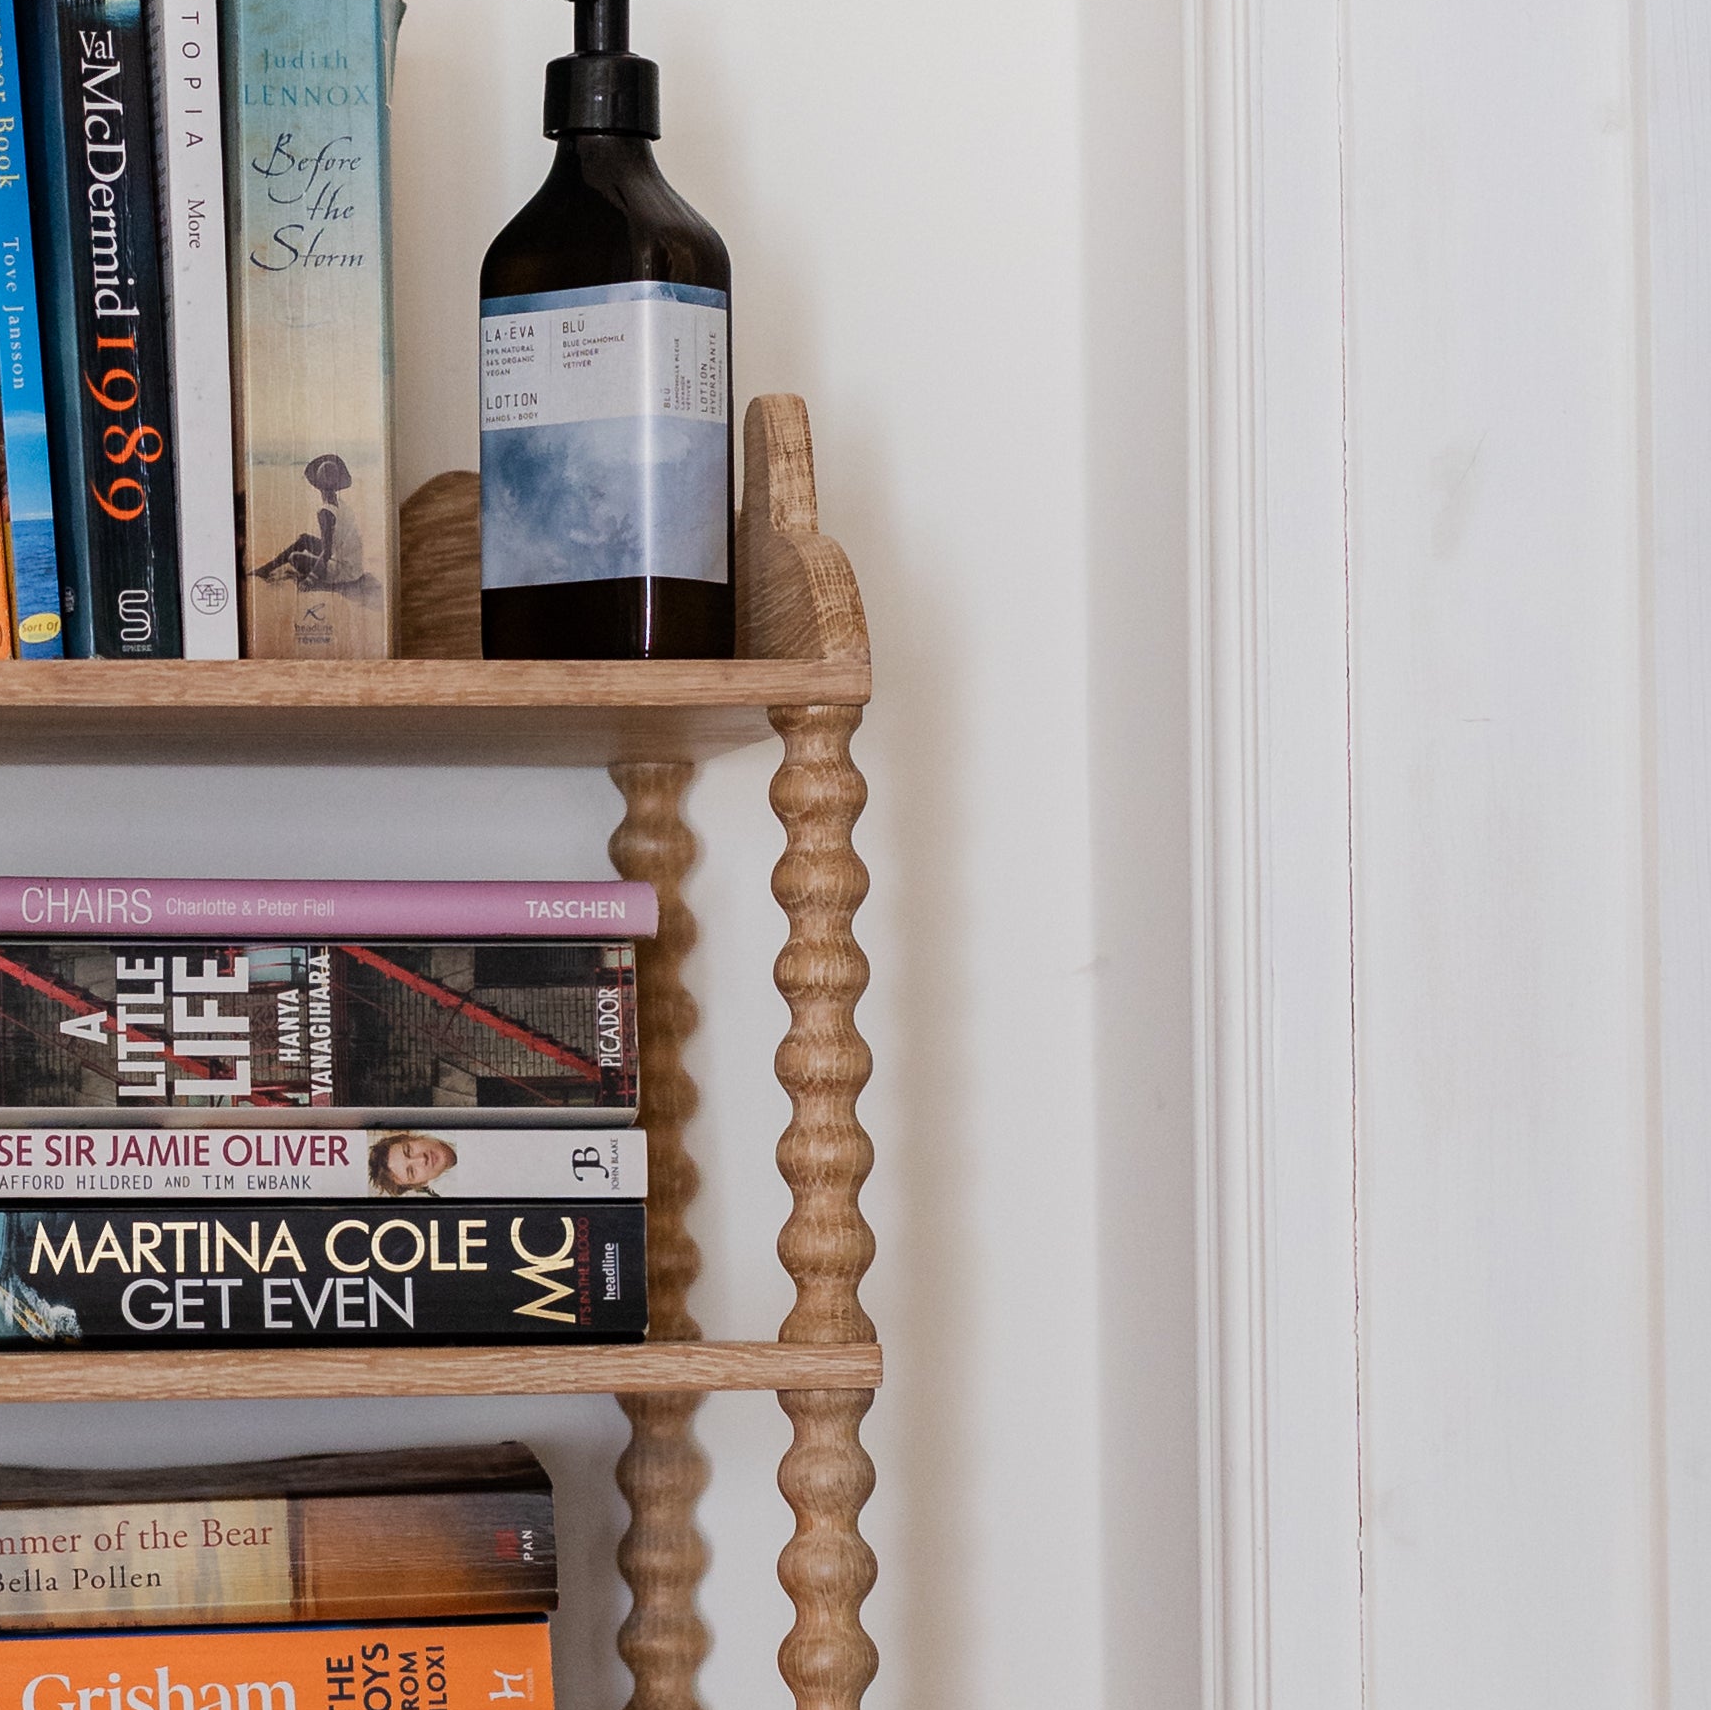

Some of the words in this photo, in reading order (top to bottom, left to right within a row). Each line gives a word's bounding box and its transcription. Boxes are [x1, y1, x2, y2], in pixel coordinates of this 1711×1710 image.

[79, 31, 114, 59] Val
[263, 49, 348, 73] Judith
[244, 85, 369, 106] LENNOX
[81, 60, 140, 319] McDermid
[252, 133, 361, 204] Before
[188, 198, 205, 250] More
[3, 238, 20, 293] Tove
[3, 305, 24, 389] Jansson
[85, 332, 163, 521] 1989
[486, 392, 538, 411] LOTION
[21, 887, 153, 924] CHAIRS
[166, 896, 237, 917] Charlotte
[257, 899, 297, 917] Peter
[303, 900, 335, 917] Fiell
[525, 900, 626, 919] TASCHEN
[117, 956, 166, 1097] LITTLE
[172, 956, 251, 1096] LIFE
[106, 1135, 210, 1167] JAMIE
[223, 1135, 350, 1167] OLIVER
[76, 1175, 153, 1190] HILDRED
[203, 1175, 235, 1190] TIM
[247, 1175, 312, 1190] EWBANK
[28, 1219, 307, 1275] MARTINA
[325, 1219, 488, 1273] COLE
[121, 1278, 243, 1331] GET
[263, 1276, 414, 1330] EVEN
[72, 1565, 162, 1590] Pollen
